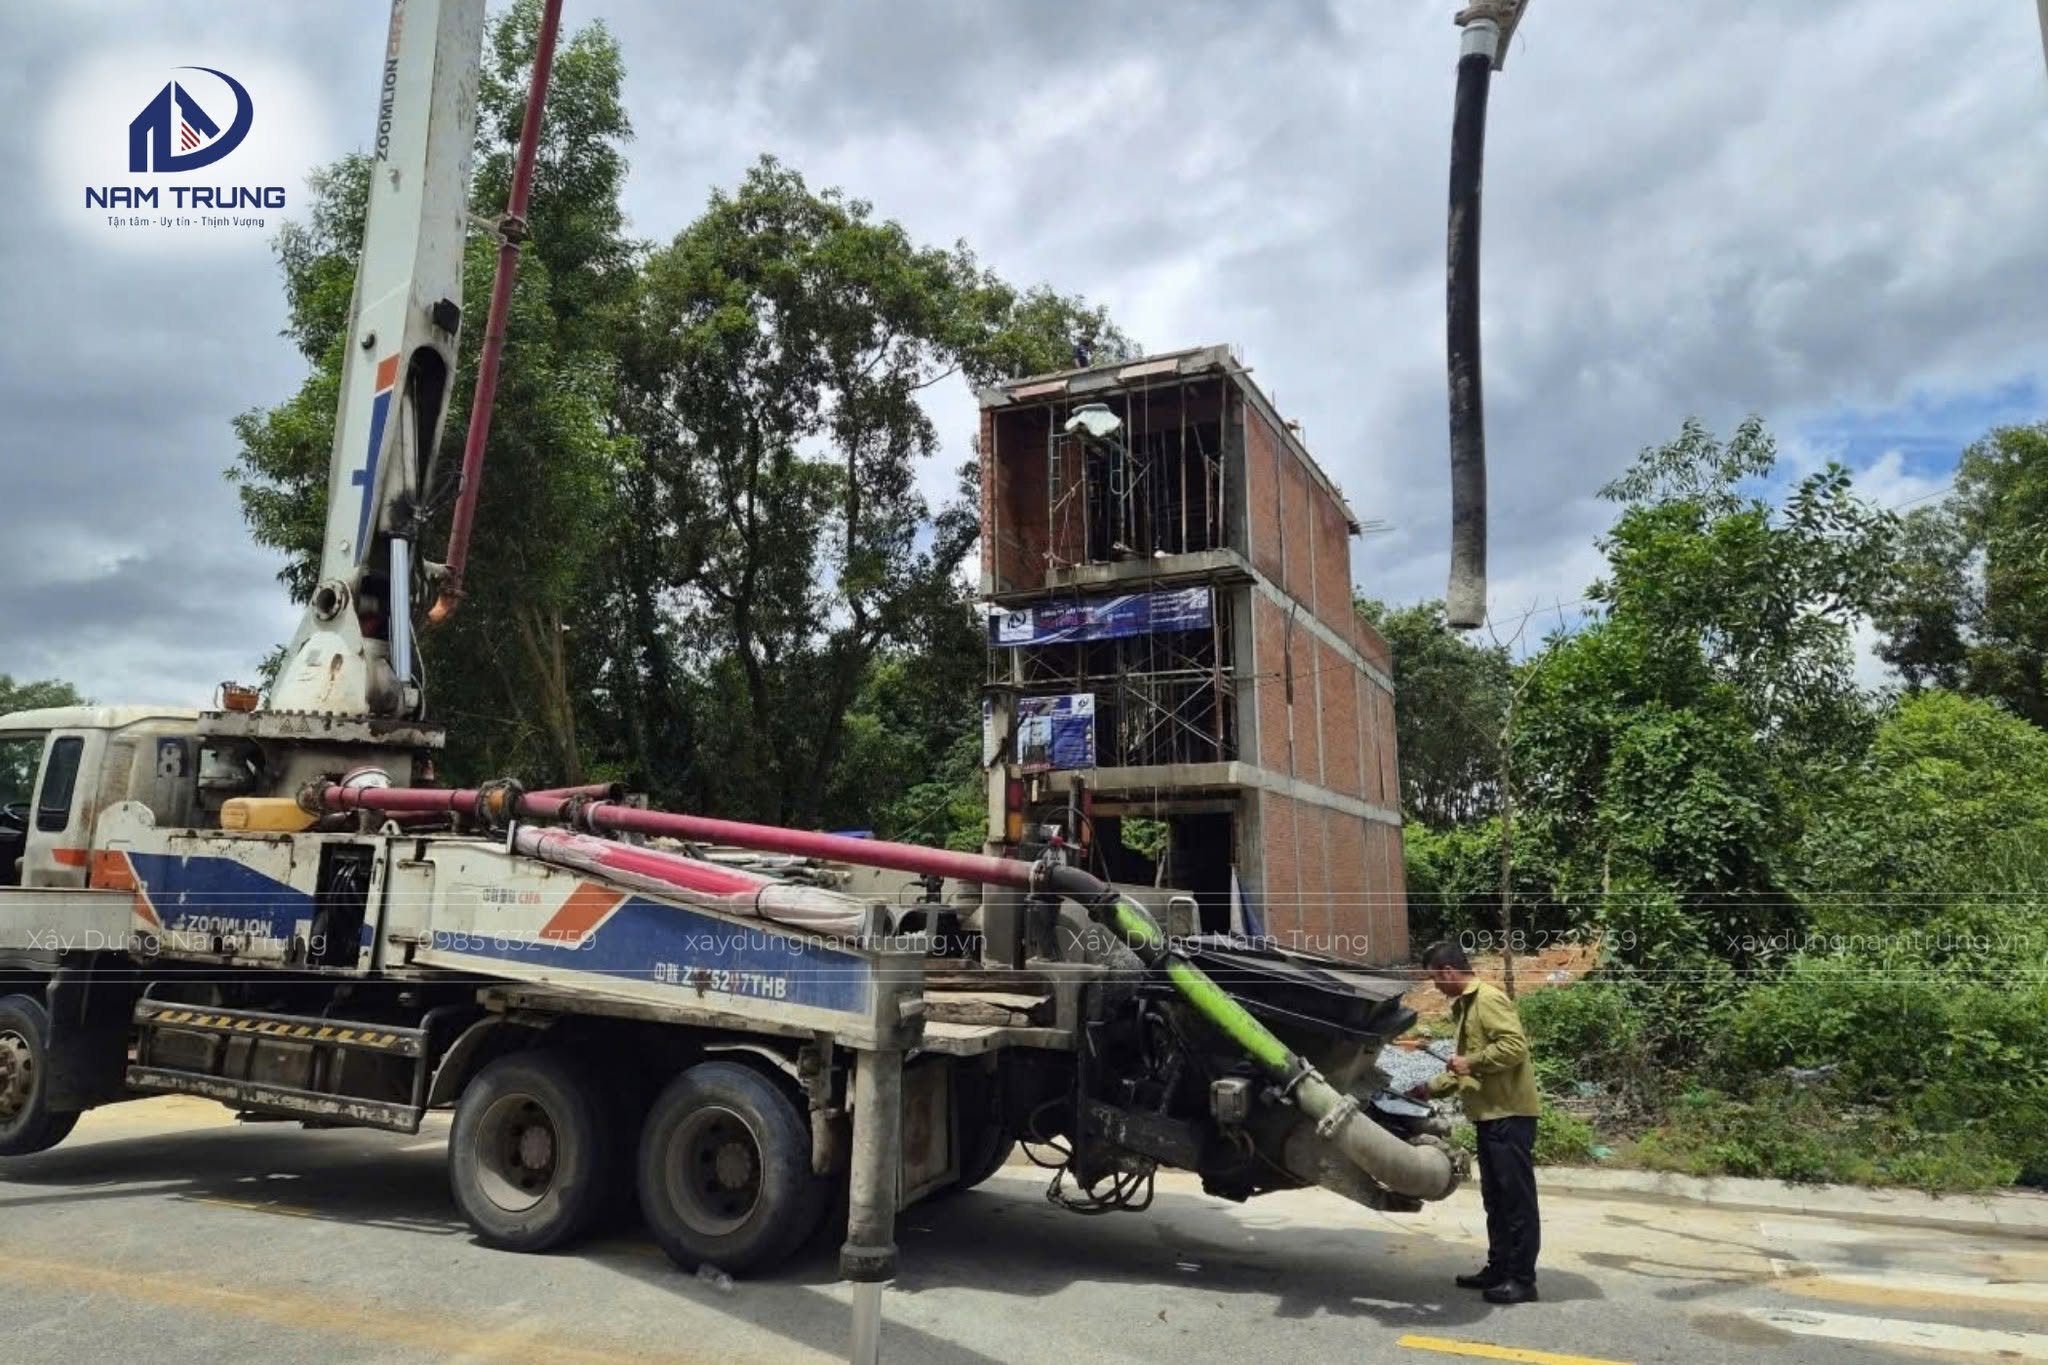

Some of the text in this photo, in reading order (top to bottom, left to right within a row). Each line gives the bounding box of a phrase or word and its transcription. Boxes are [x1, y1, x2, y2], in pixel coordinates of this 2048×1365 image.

[376, 58, 399, 162] ZOOMLION
[187, 914, 273, 938] ZOOMLION
[682, 965, 787, 999] Z527THB
